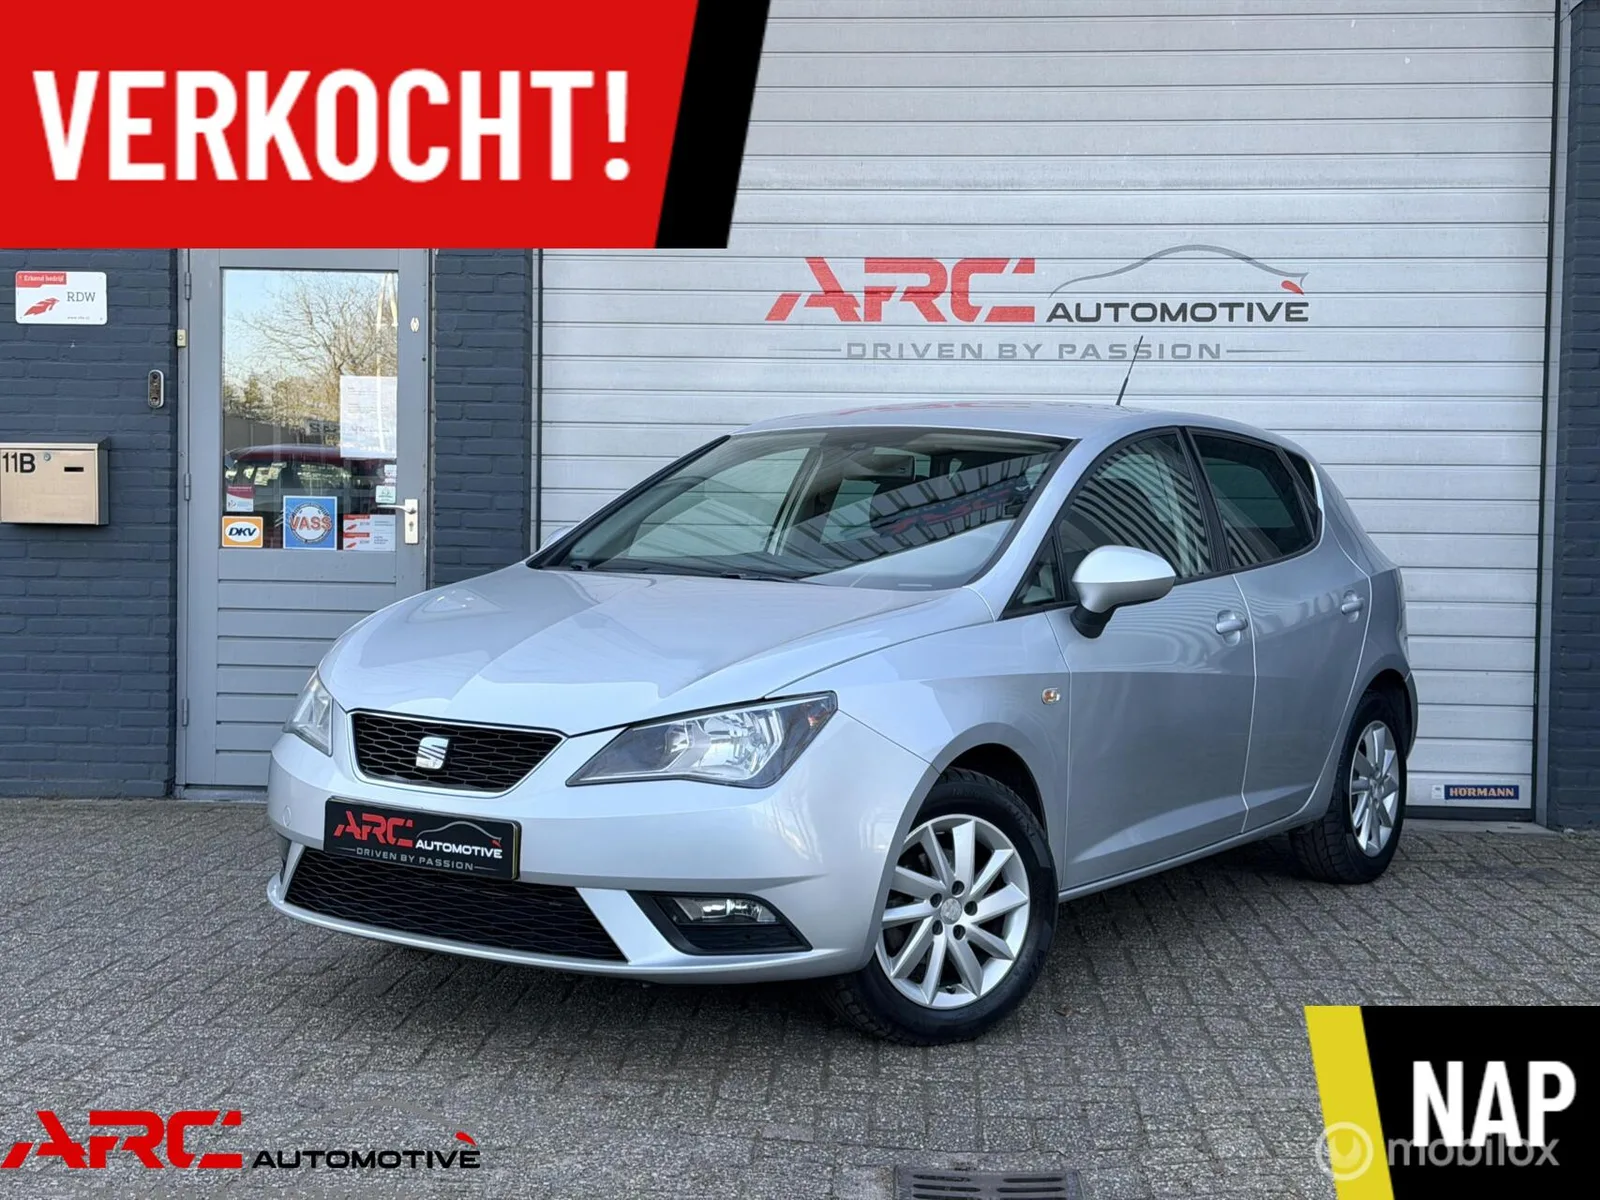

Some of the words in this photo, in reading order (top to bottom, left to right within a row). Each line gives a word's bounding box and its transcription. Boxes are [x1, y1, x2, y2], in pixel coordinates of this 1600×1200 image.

[66, 291, 96, 302] RDW
[764, 257, 1036, 323] ARC
[1046, 302, 1309, 323] AUTOMOTIVE
[846, 342, 987, 360] DRIVEN
[1000, 342, 1042, 359] BY
[1058, 342, 1222, 360] PASSION
[1, 452, 36, 474] 11B
[228, 527, 257, 537] DKV
[290, 516, 332, 531] VASS
[333, 810, 413, 848] ARC
[415, 838, 503, 859] AUTOMOTIVE
[356, 846, 397, 861] DRIVEN
[400, 853, 415, 863] BY
[419, 856, 474, 871] PASSION
